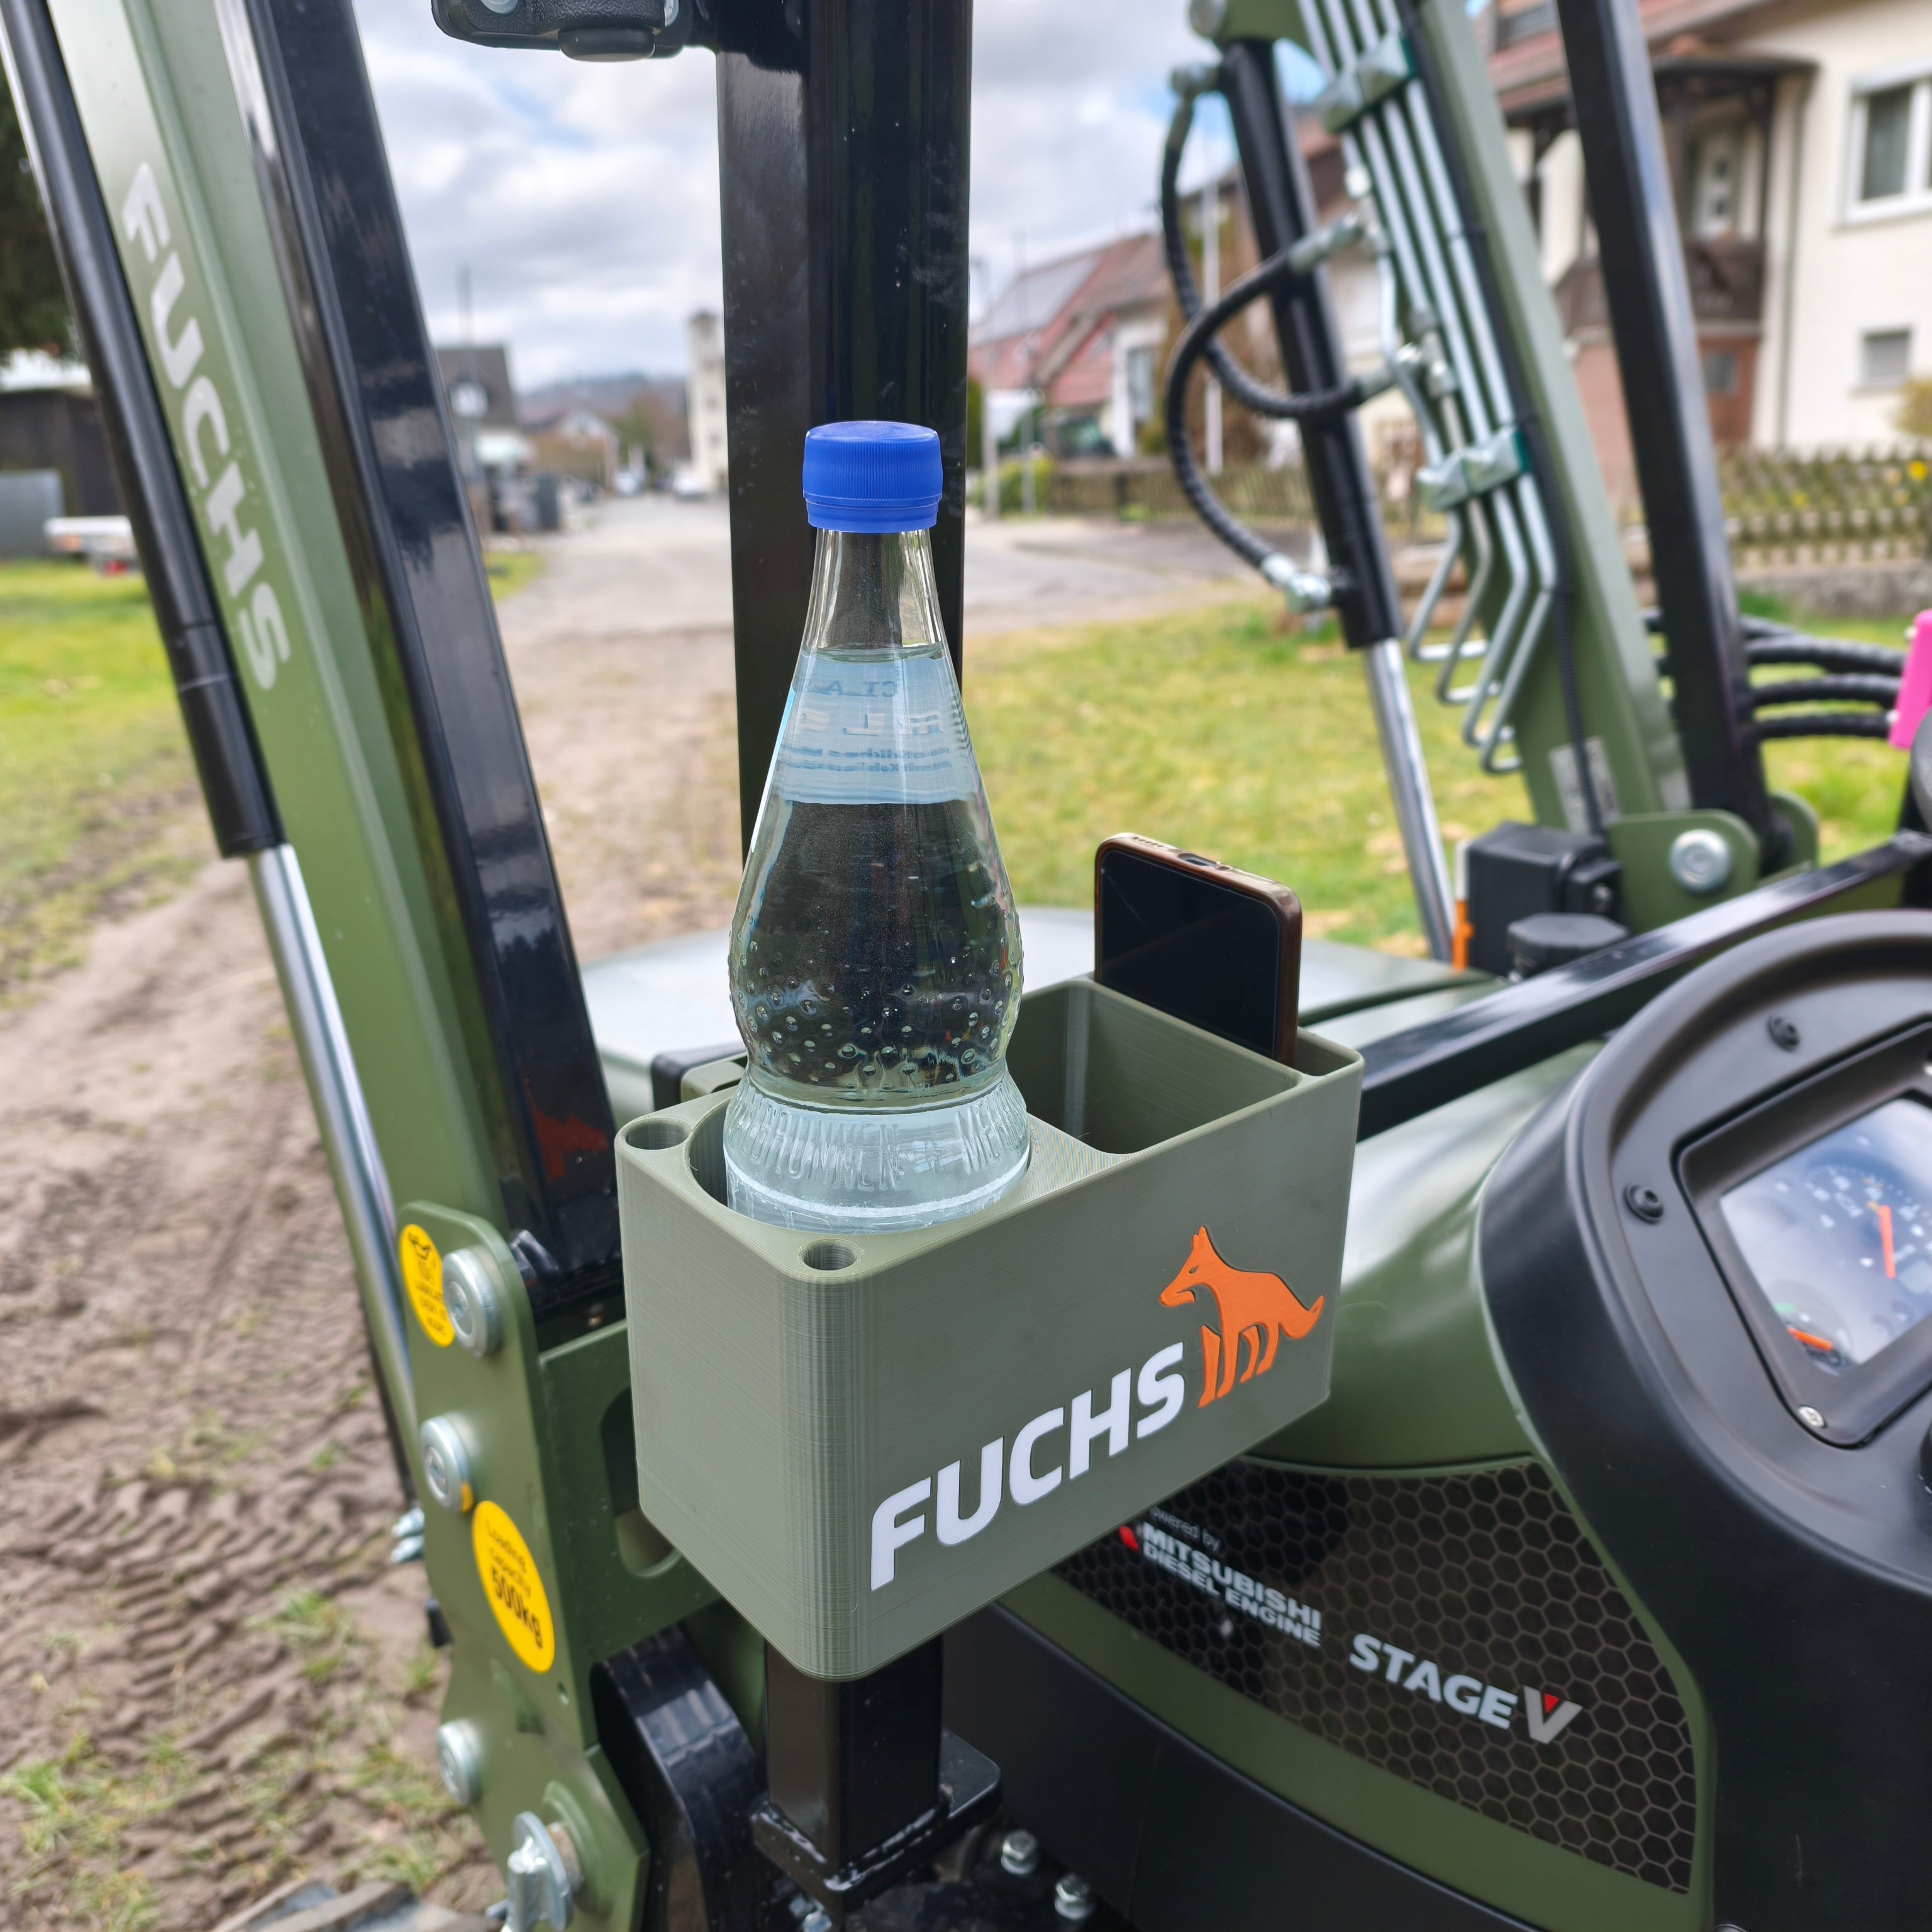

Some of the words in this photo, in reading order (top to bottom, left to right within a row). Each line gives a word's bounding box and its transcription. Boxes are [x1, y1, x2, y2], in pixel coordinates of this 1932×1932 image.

[121, 162, 291, 691] FUCHS
[871, 1341, 1186, 1592] FUCHS
[1142, 1521, 1322, 1630] MITSUBISHI
[1150, 1506, 1200, 1541] owered
[1202, 1528, 1221, 1553] by
[491, 1565, 543, 1650] 500kg
[1143, 1541, 1221, 1599] DIESEL
[1225, 1585, 1322, 1649] ENGINE
[1349, 1633, 1519, 1730] STAGE
[1523, 1685, 1584, 1745] V
